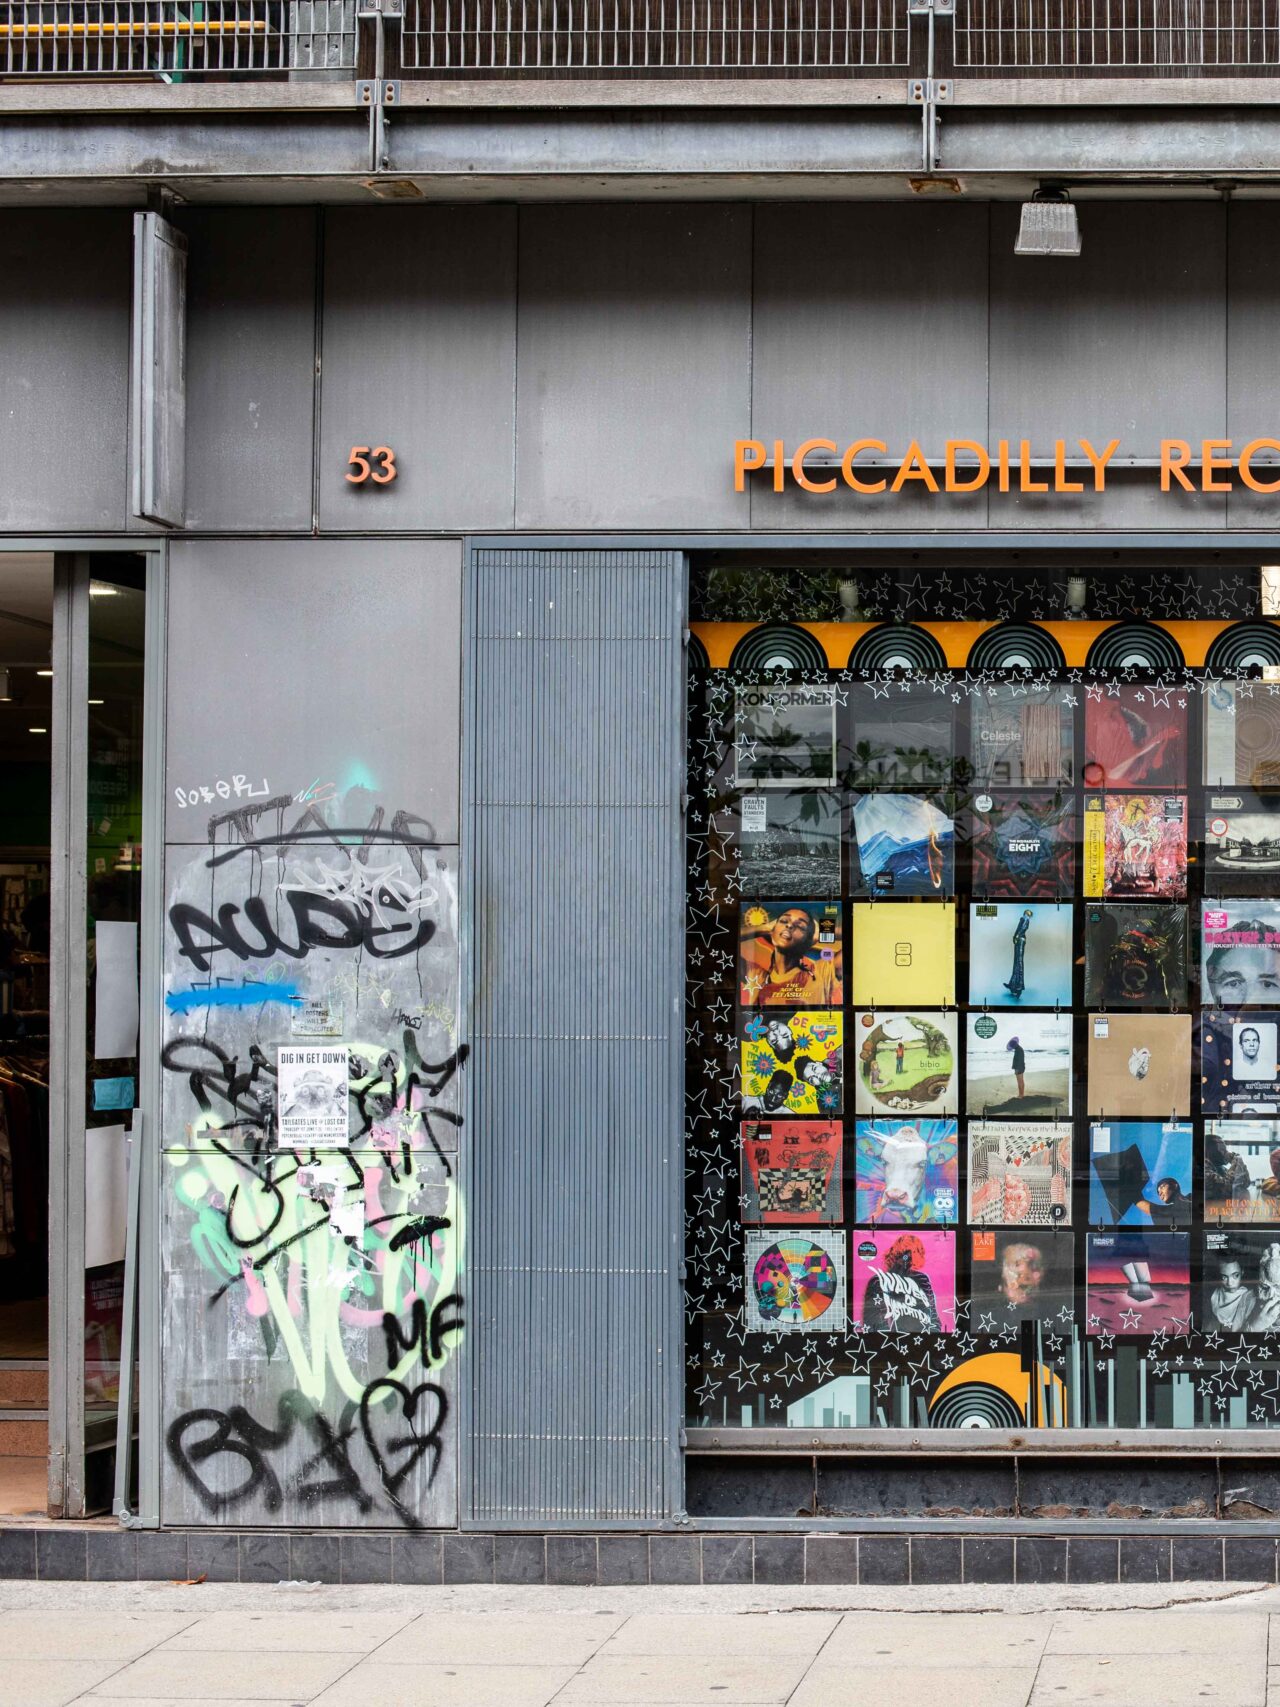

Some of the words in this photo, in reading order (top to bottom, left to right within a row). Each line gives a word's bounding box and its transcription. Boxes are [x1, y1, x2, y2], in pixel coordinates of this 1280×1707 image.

[345, 446, 397, 484] 53
[733, 438, 1121, 493] PICCADILLY
[980, 731, 1021, 742] Celeste
[1008, 843, 1041, 852] EIGHT
[792, 1017, 809, 1029] DE
[281, 1053, 294, 1064] DIG
[296, 1053, 304, 1064] IN
[306, 1053, 320, 1064] GET
[322, 1053, 346, 1064] DOWN
[919, 1060, 940, 1068] bibio
[307, 1118, 318, 1126] LIVE
[867, 1265, 930, 1307] WAVES
